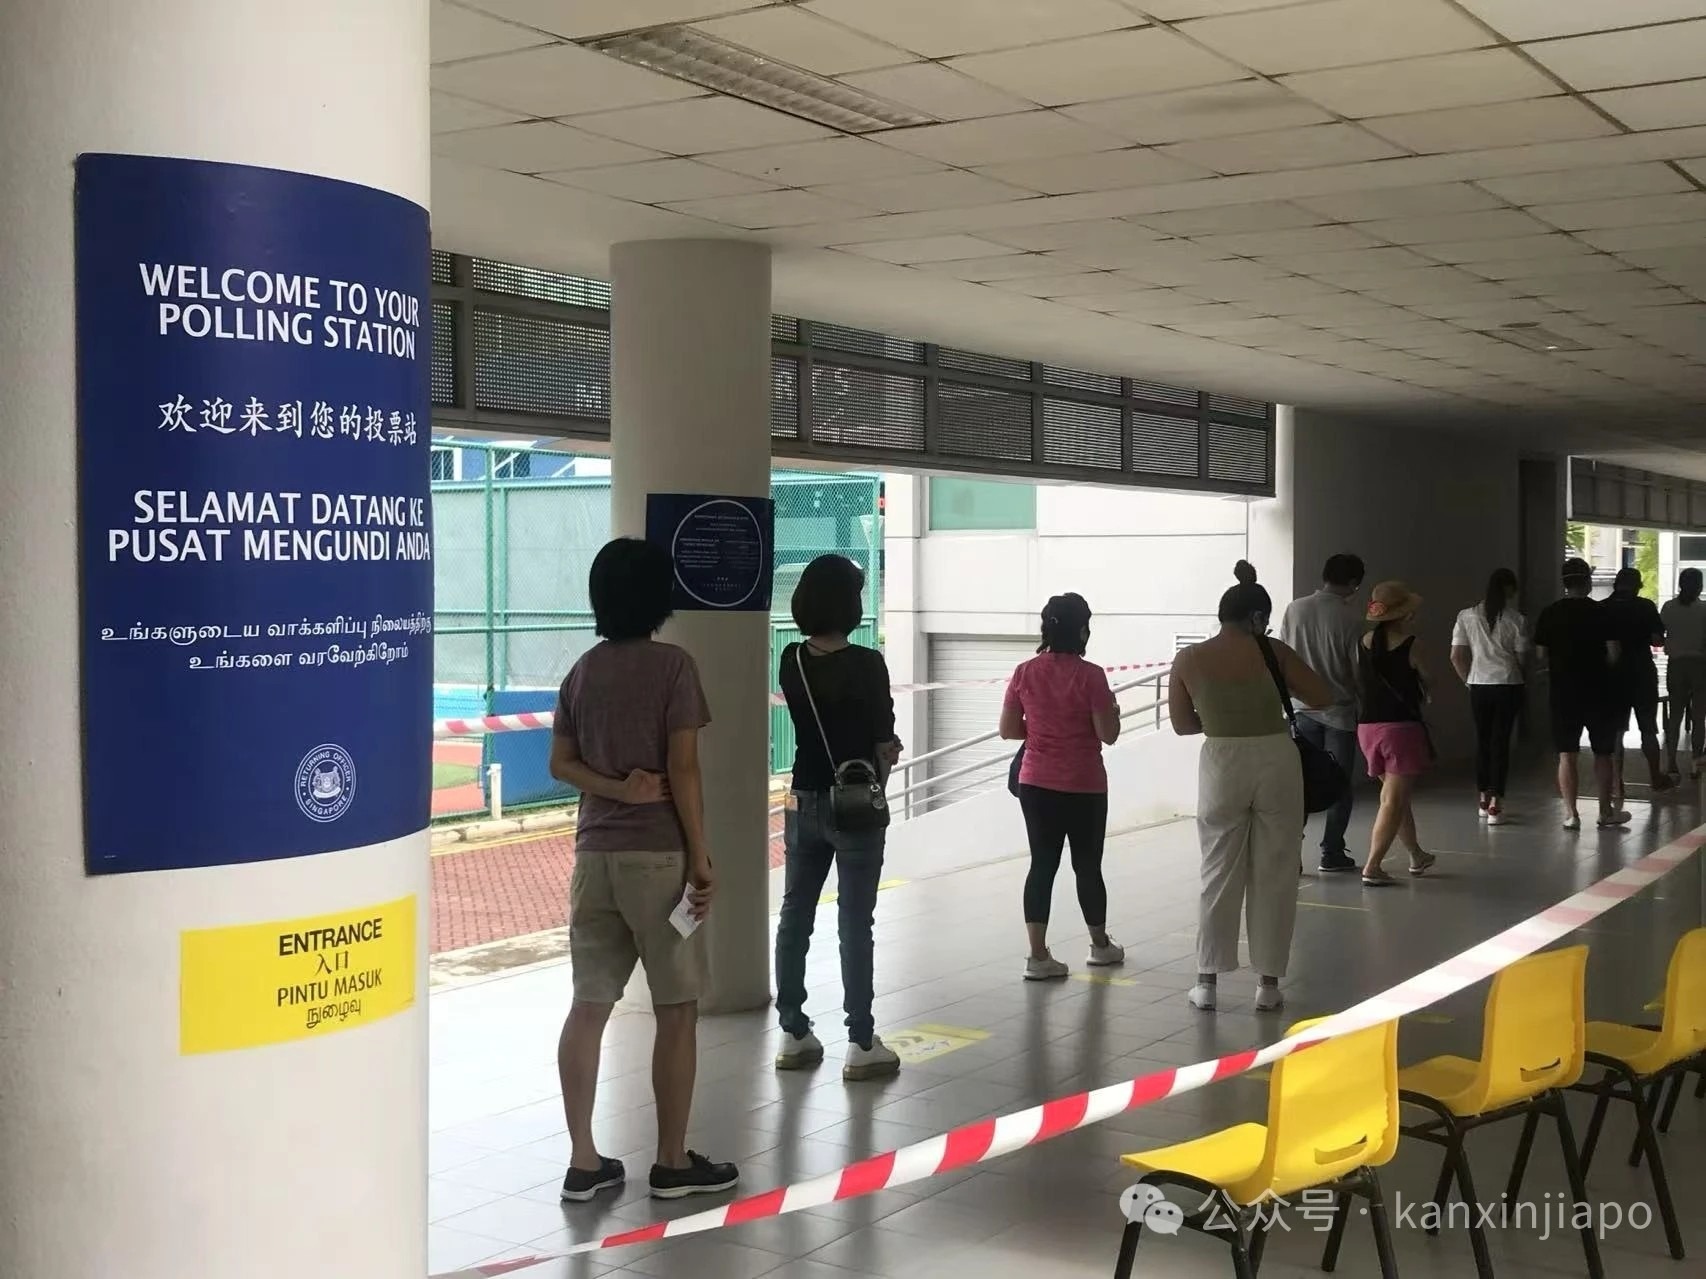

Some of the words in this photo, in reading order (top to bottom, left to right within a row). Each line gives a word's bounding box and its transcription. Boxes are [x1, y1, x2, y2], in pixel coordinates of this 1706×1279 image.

[139, 263, 321, 309] WELCOME
[329, 280, 368, 315] TO
[374, 287, 420, 328] YOUR
[159, 303, 313, 346] POLLING
[323, 315, 416, 360] STATION
[157, 393, 417, 447] 欢迎来到您的投票站
[134, 489, 302, 524] SELAMAT
[311, 493, 406, 527] DATANG
[410, 497, 424, 526] KE
[108, 528, 232, 562] PUSAT
[244, 529, 390, 562] MENGUNDI
[396, 531, 431, 561] ANDA
[101, 621, 260, 646] உங்களுடைய
[267, 615, 367, 639] வாக்களிப்பு
[189, 650, 293, 669] உங்களை
[298, 641, 409, 668] வரவேற்கிறோம்
[301, 751, 330, 787] RETURNING
[332, 752, 352, 782] OFFICER
[305, 795, 347, 815] SINGAPORE
[279, 918, 383, 956] ENTRANCE
[314, 950, 349, 976] 入口
[277, 980, 329, 1007] PINTU
[333, 968, 383, 997] MASUK
[306, 999, 362, 1029] நுழைவு
